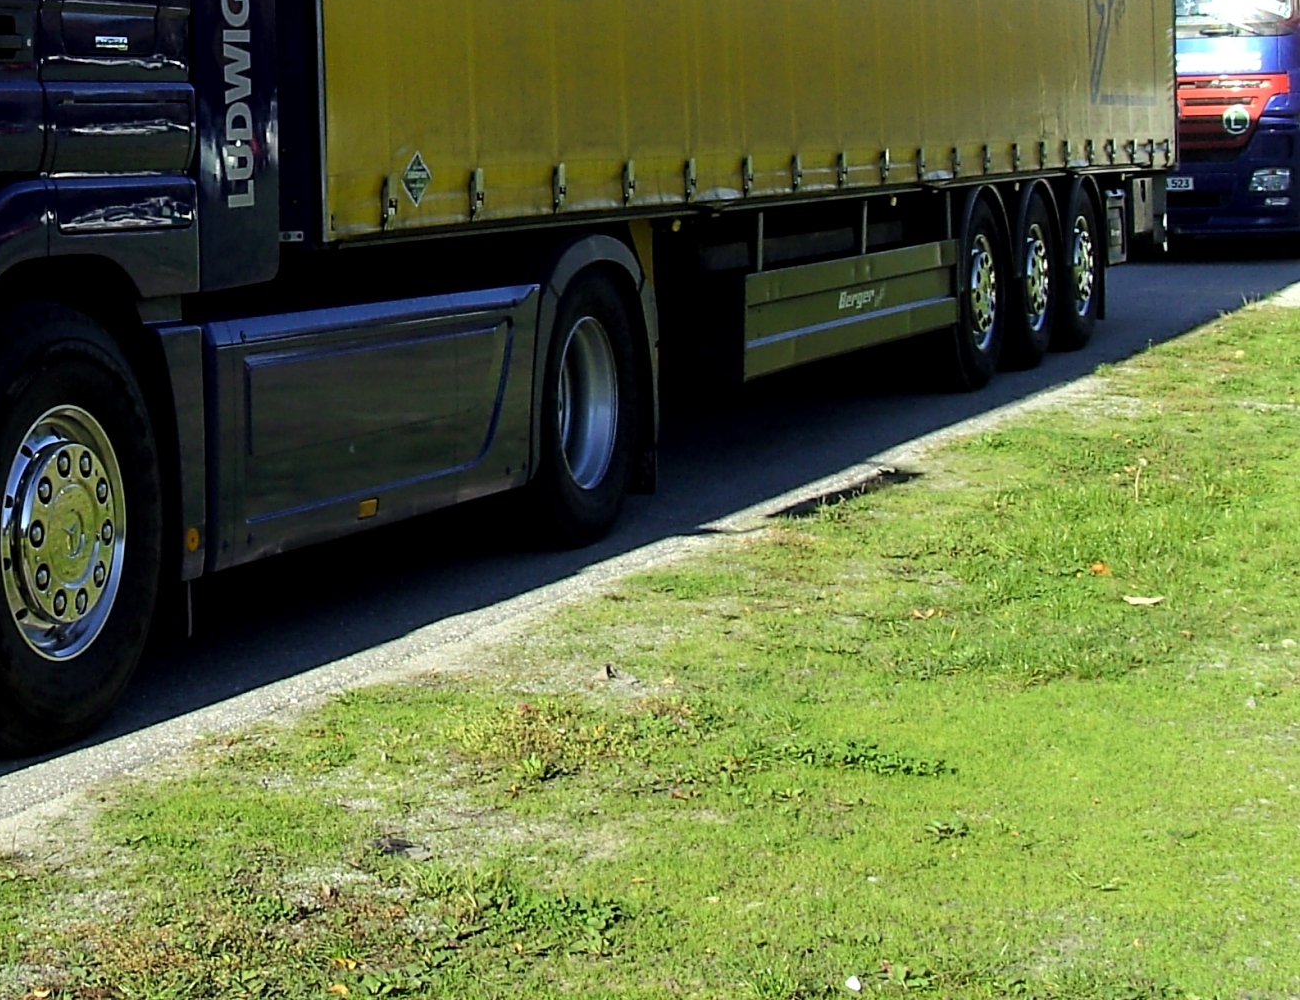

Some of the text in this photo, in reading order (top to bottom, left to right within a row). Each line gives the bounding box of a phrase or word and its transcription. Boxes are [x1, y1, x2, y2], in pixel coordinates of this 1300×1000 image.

[1231, 112, 1242, 129] L
[1171, 178, 1190, 189] 523
[838, 289, 875, 309] Berger
